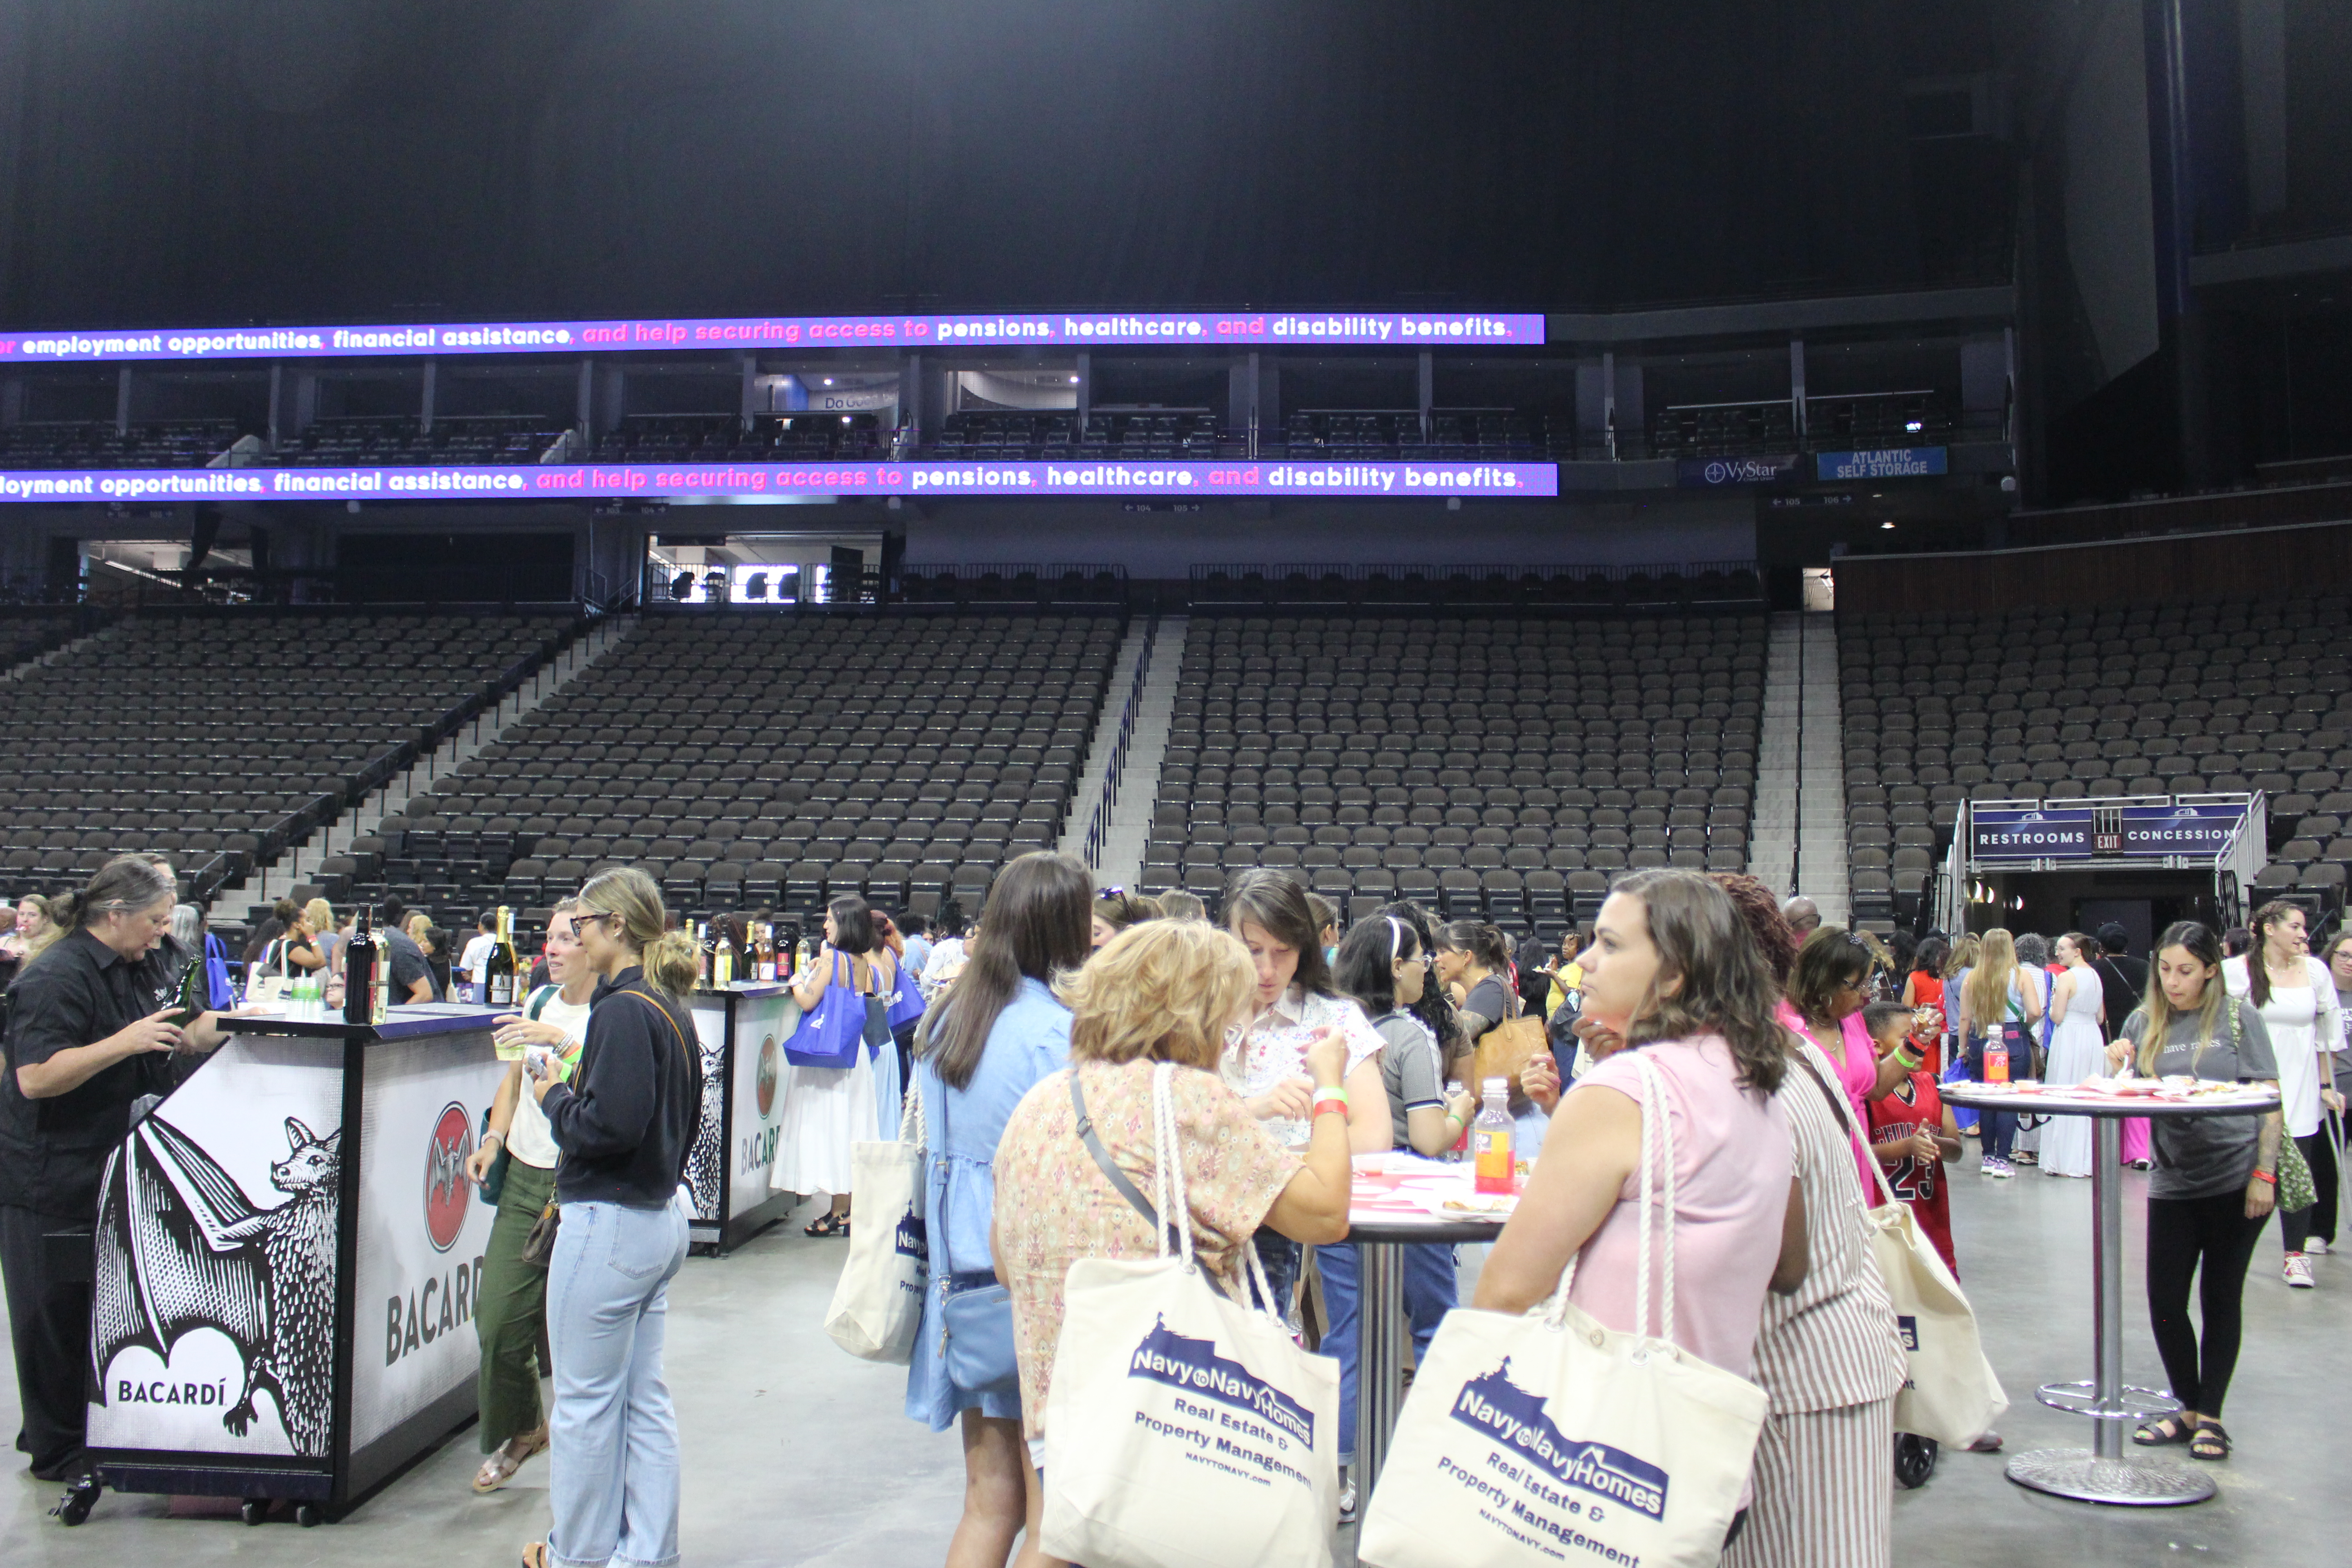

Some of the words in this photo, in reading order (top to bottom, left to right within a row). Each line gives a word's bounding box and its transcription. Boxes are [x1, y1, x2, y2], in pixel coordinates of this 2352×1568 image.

[23, 335, 161, 356] employment
[168, 332, 325, 354] opportunities,
[333, 329, 434, 347] financial
[443, 328, 575, 345] assistance,
[583, 324, 627, 342] and
[636, 323, 687, 343] help
[696, 322, 800, 343] securing
[810, 324, 895, 338] access
[904, 321, 929, 336] to
[938, 319, 1055, 340] pensions,
[1065, 318, 1207, 336] healthcare,
[1217, 317, 1264, 334] and
[1273, 318, 1392, 339] disability
[1402, 318, 1512, 336] benefits.
[825, 397, 843, 408] Do
[1725, 461, 1777, 482] VyStar
[1838, 464, 1867, 478] SELF
[1871, 461, 1927, 476] STORAGE
[1852, 449, 1912, 466] ATLANTIC
[101, 474, 265, 496] opportunities,
[274, 472, 380, 491] financial
[389, 471, 528, 490] assistance,
[537, 470, 584, 488] and
[593, 470, 647, 490] help
[656, 469, 766, 490] securing
[777, 471, 867, 485] access
[877, 468, 902, 485] to
[913, 467, 1037, 489] pensions,
[1048, 466, 1198, 486] healthcare,
[1209, 467, 1258, 485] and
[1269, 467, 1395, 490] disability
[1406, 468, 1523, 487] benefits.
[1980, 832, 2085, 845] RESTROOMS
[2097, 835, 2119, 849] EXIT
[2127, 829, 2234, 841] CONCESSION
[740, 1125, 780, 1176] BACAR
[1884, 1155, 1936, 1200] 23
[118, 1377, 226, 1406] BACARDÍ
[1174, 1398, 1215, 1422] Real
[1220, 1412, 1274, 1443] Estate
[1278, 1437, 1289, 1451] &
[1135, 1411, 1211, 1449] Property
[1216, 1437, 1312, 1491] Management
[1186, 1452, 1271, 1487] NAVYTONAVY.com
[1487, 1451, 1525, 1483] Real
[1524, 1474, 1581, 1514] Estate
[1588, 1506, 1605, 1522] &
[1438, 1456, 1511, 1509] Property
[1511, 1499, 1640, 1568] Management
[1479, 1508, 1565, 1561] NAVYTONAVY.com
